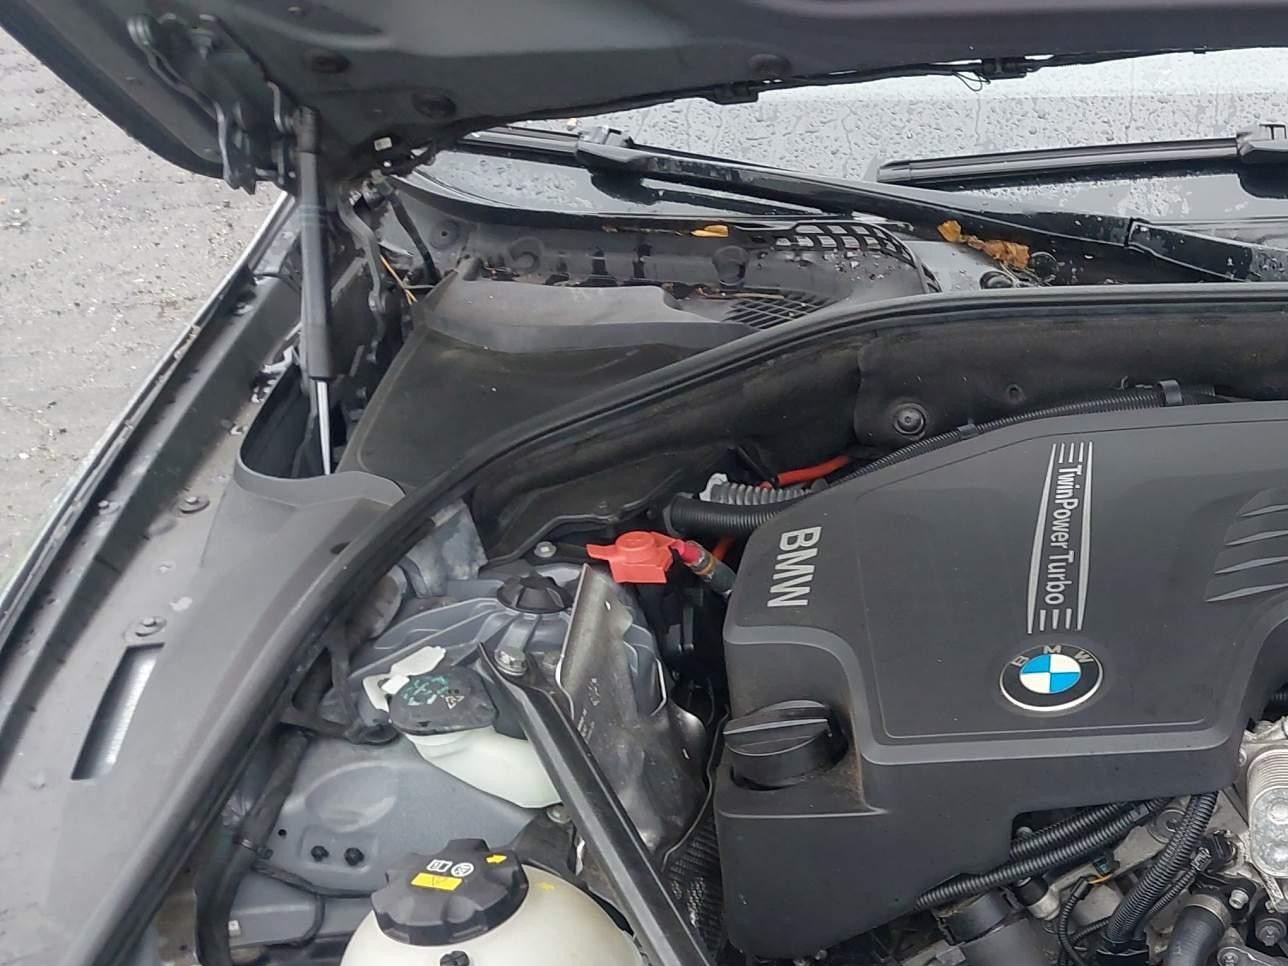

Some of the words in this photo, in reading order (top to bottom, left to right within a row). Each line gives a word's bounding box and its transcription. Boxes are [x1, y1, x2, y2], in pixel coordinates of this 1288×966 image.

[1050, 464, 1083, 549] TwinPower
[767, 526, 822, 607] BMW
[1045, 550, 1075, 605] Turbo
[1011, 644, 1095, 667] BMW
